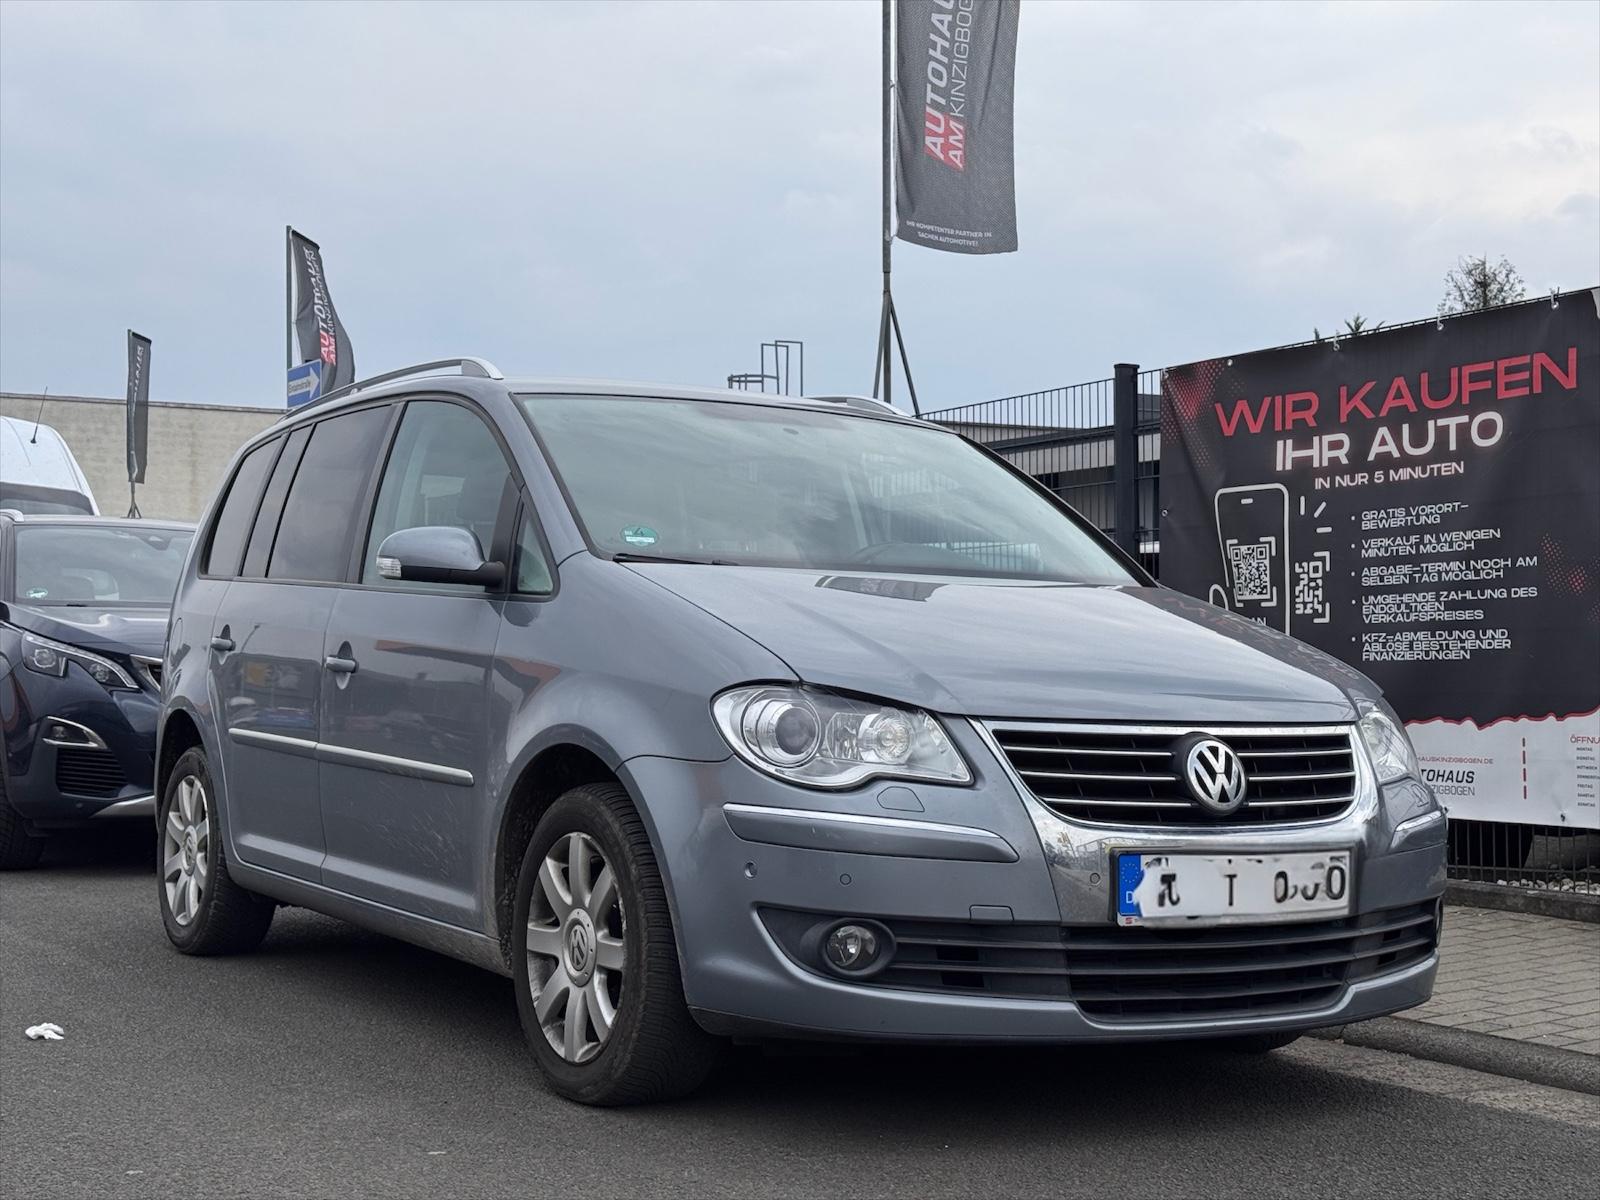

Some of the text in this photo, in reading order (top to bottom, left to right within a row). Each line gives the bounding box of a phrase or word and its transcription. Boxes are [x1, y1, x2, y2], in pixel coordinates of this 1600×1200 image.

[948, 120, 964, 169] AM
[1214, 347, 1578, 437] WIR KAUFEN
[1275, 410, 1505, 472] IHR AUTO
[1314, 461, 1465, 490] IN NUR 5 MINUTEN
[1361, 507, 1406, 521] GRATIS
[1361, 514, 1441, 530] BEWERTUNG
[1362, 528, 1501, 549] VERKAUF IN WENIGEN
[1361, 545, 1416, 559] MINUTEN
[1361, 556, 1538, 577] ABGABE-TERMIN NOCH AM
[1361, 573, 1410, 587] SELBEN
[1413, 572, 1439, 584] TAG
[1362, 587, 1538, 605] UMGEHENDE ZAHLUNG DES
[1362, 609, 1485, 624] VERKAUFSPREISES
[1362, 628, 1509, 643] KFZ-ABMELDUNG UND
[1362, 639, 1512, 652] ABLÖSE BESTEHENDER
[1362, 650, 1471, 662] FINANZIERUNGEN
